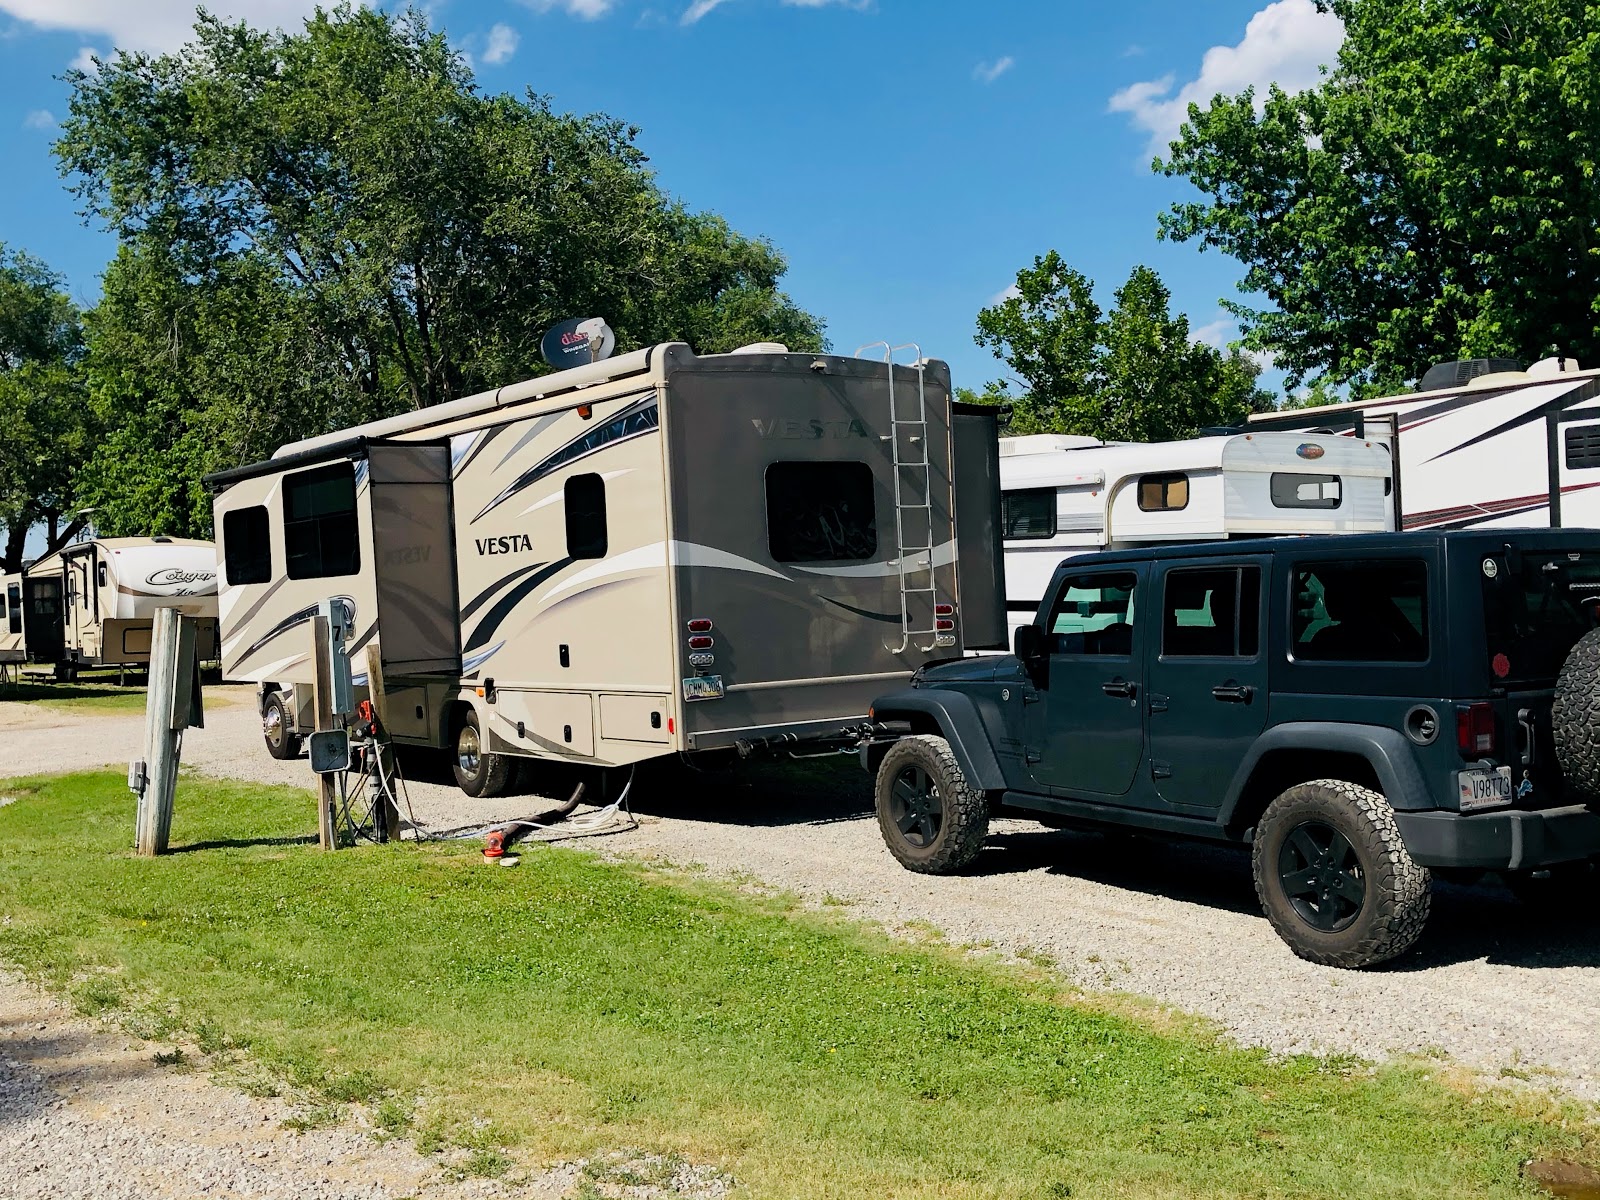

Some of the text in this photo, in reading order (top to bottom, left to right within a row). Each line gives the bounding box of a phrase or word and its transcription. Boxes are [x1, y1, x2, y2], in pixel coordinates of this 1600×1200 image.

[751, 418, 868, 440] VESTA
[474, 534, 533, 556] VESTA
[145, 568, 217, 585] Cougar
[332, 625, 342, 642] 7
[1472, 776, 1510, 799] V98T73
